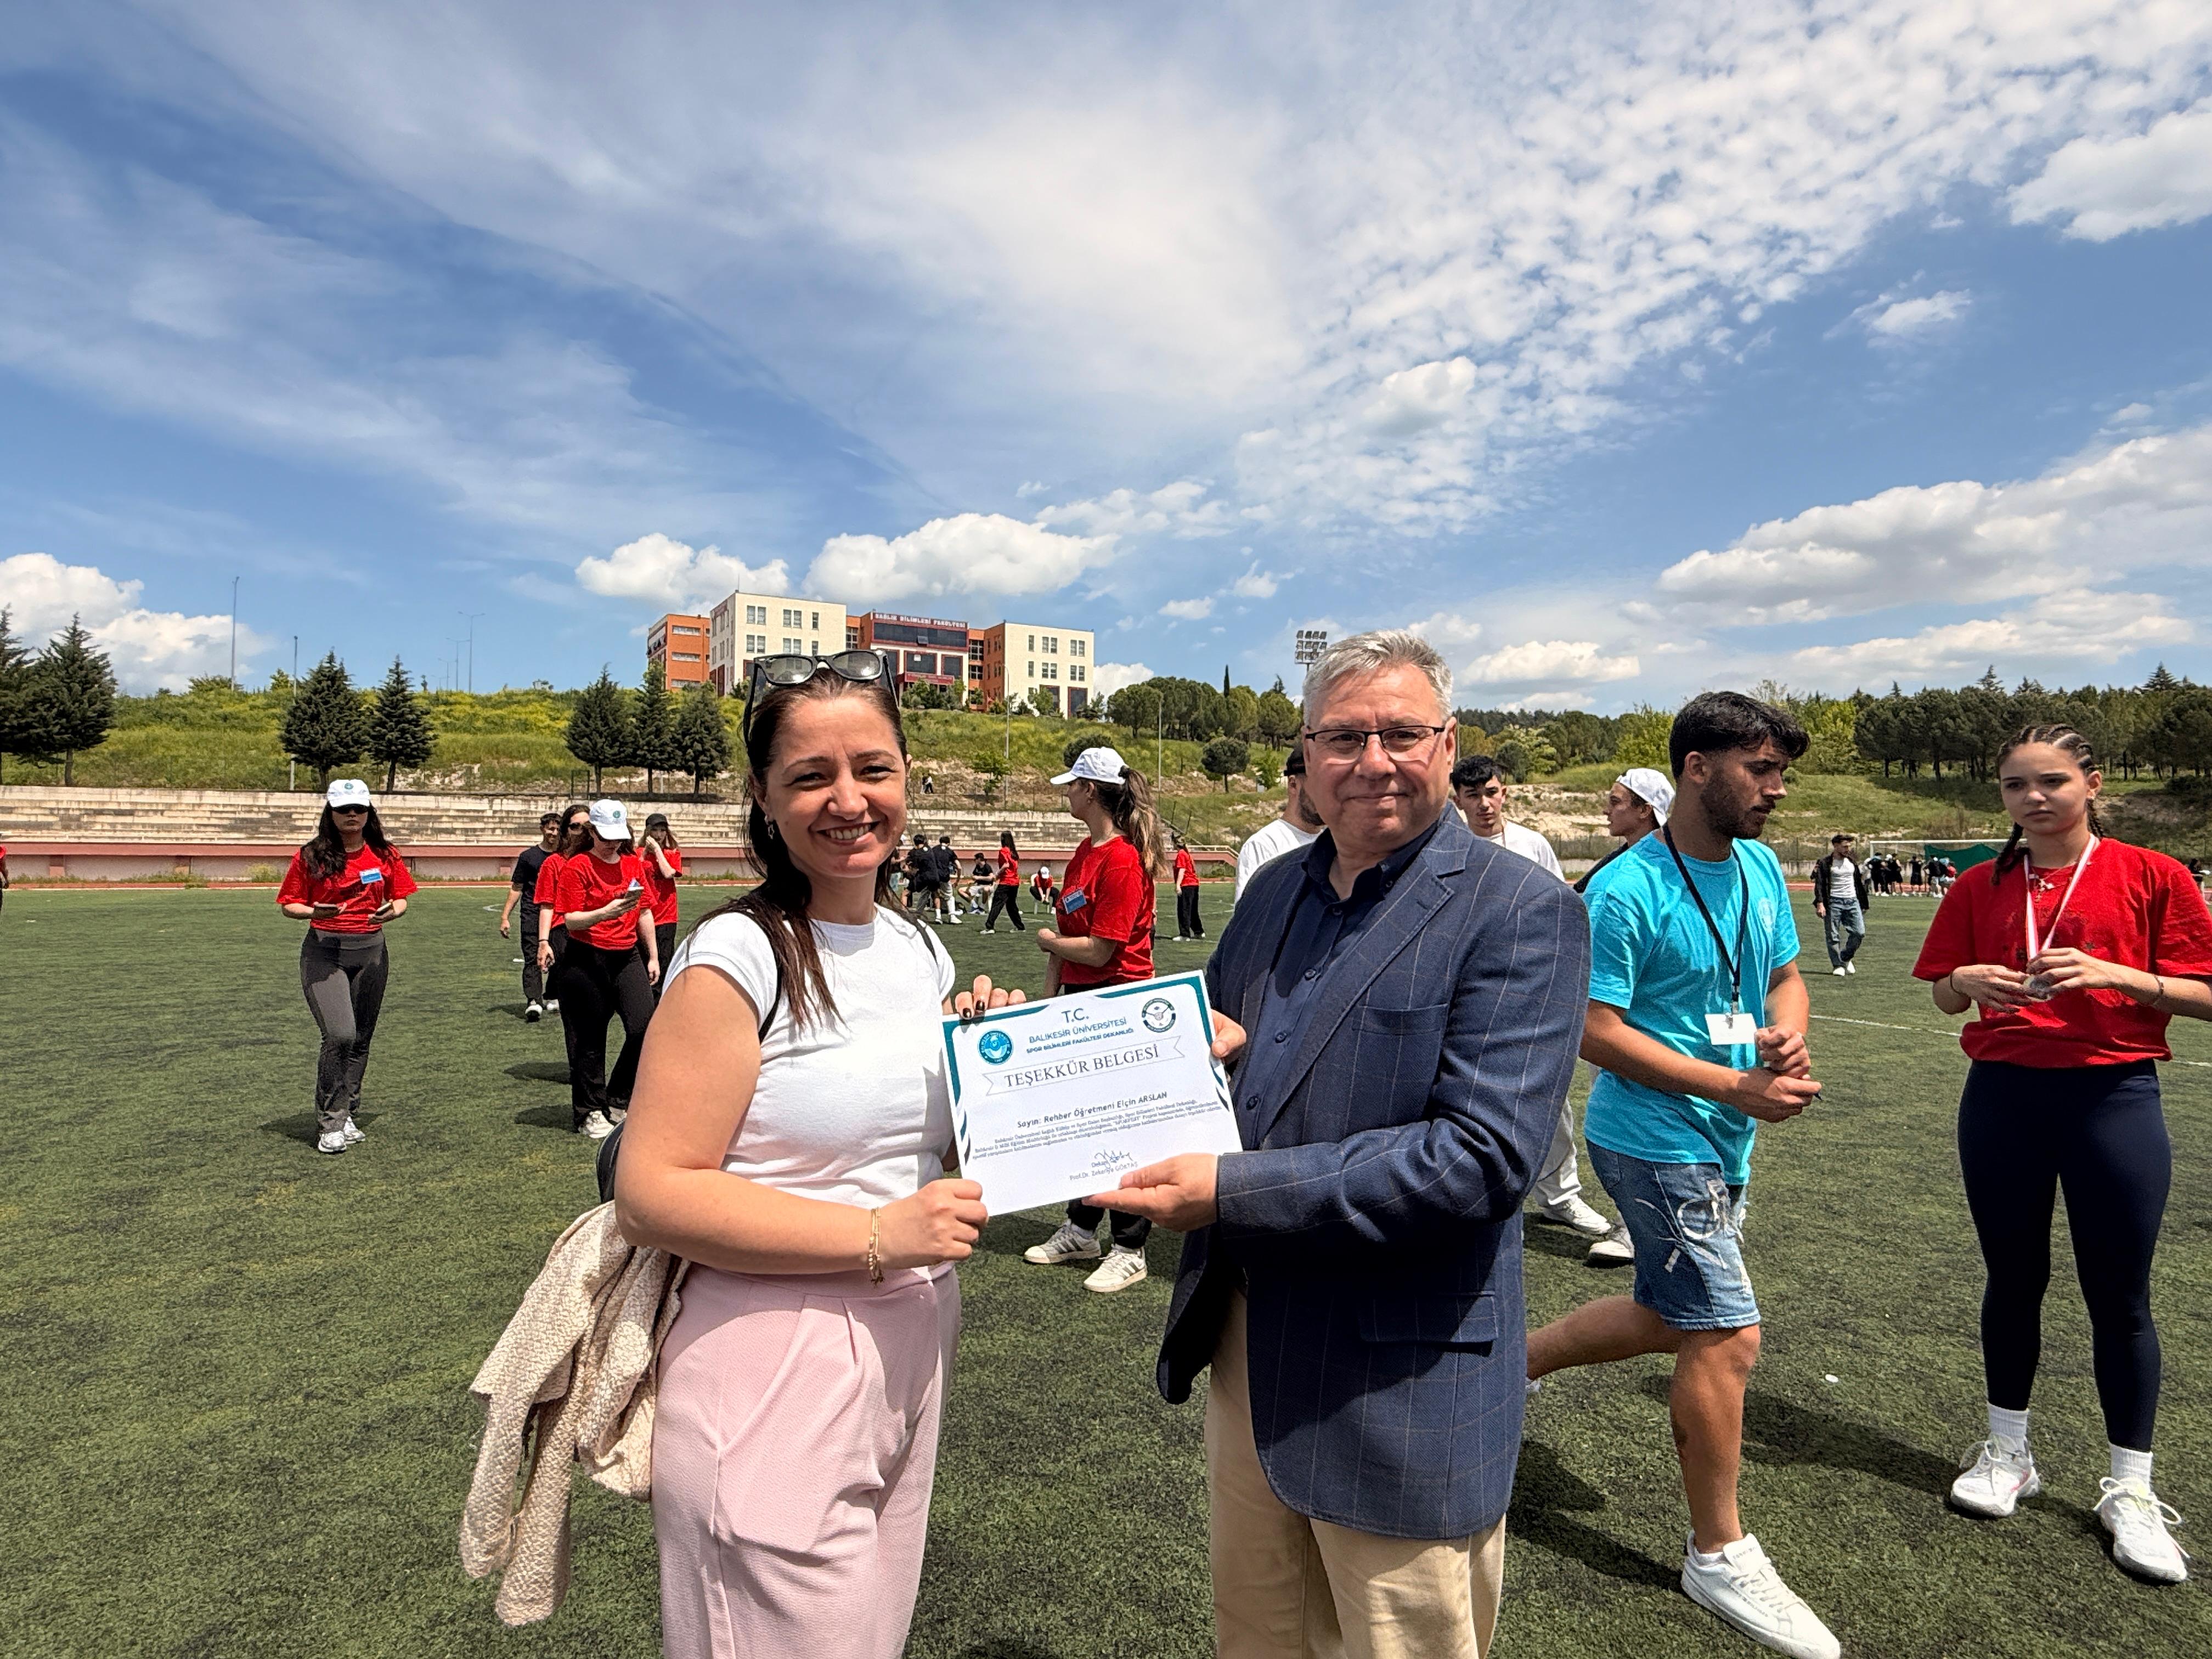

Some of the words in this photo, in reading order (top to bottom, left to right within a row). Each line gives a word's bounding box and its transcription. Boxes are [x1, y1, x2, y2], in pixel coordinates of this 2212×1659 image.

[1062, 1008, 1089, 1023] T.C.
[1029, 1030, 1070, 1043] BALIKESİR
[1073, 1017, 1126, 1034] ÜNİVERSİTESİ
[1073, 1034, 1101, 1044] FAKÜLTESİ
[1005, 1060, 1090, 1087] TEŞEKKÜR
[1093, 1044, 1158, 1070] BELGESİ
[1044, 1112, 1071, 1123] Rehber
[1074, 1102, 1114, 1116] Öğretmeni
[1118, 1099, 1136, 1108] Elçin
[1138, 1092, 1167, 1103] ARSLAN
